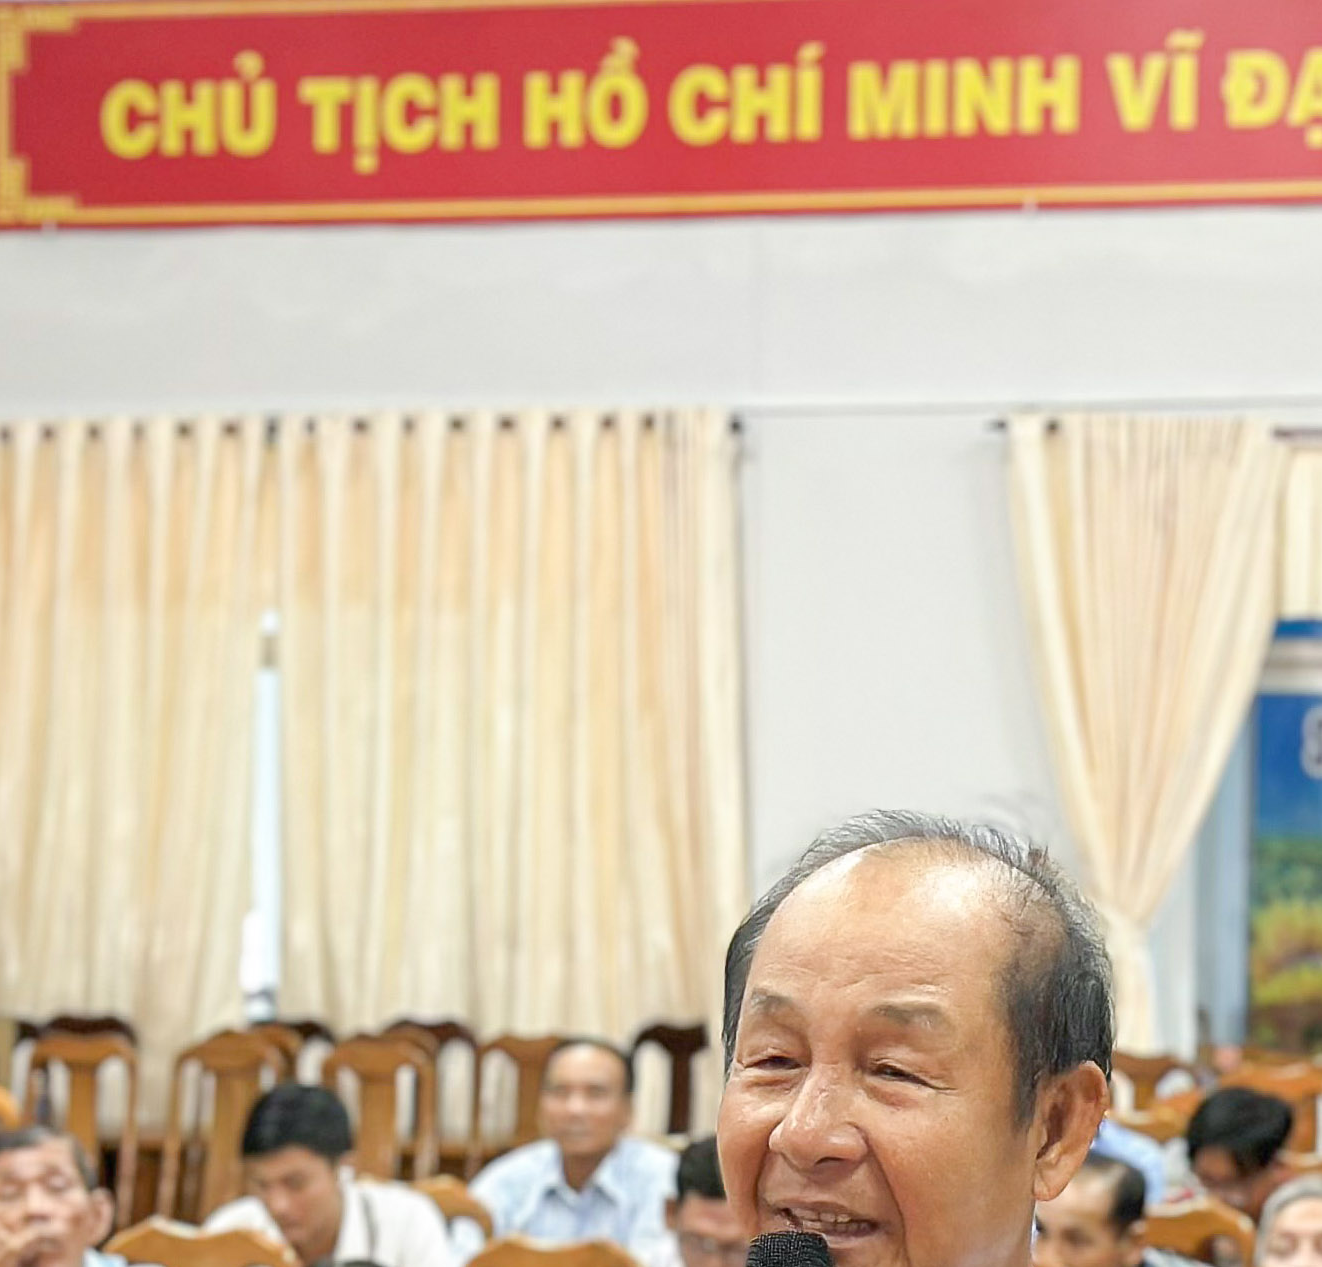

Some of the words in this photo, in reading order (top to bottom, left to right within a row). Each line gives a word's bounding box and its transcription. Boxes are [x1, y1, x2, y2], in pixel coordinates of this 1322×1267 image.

[100, 49, 278, 159] CHỦ
[298, 73, 499, 175] TỊCH
[524, 37, 648, 149] HỒ
[668, 42, 825, 147] CHÍ
[847, 55, 1080, 140] MINH
[1106, 29, 1204, 133] VĨ
